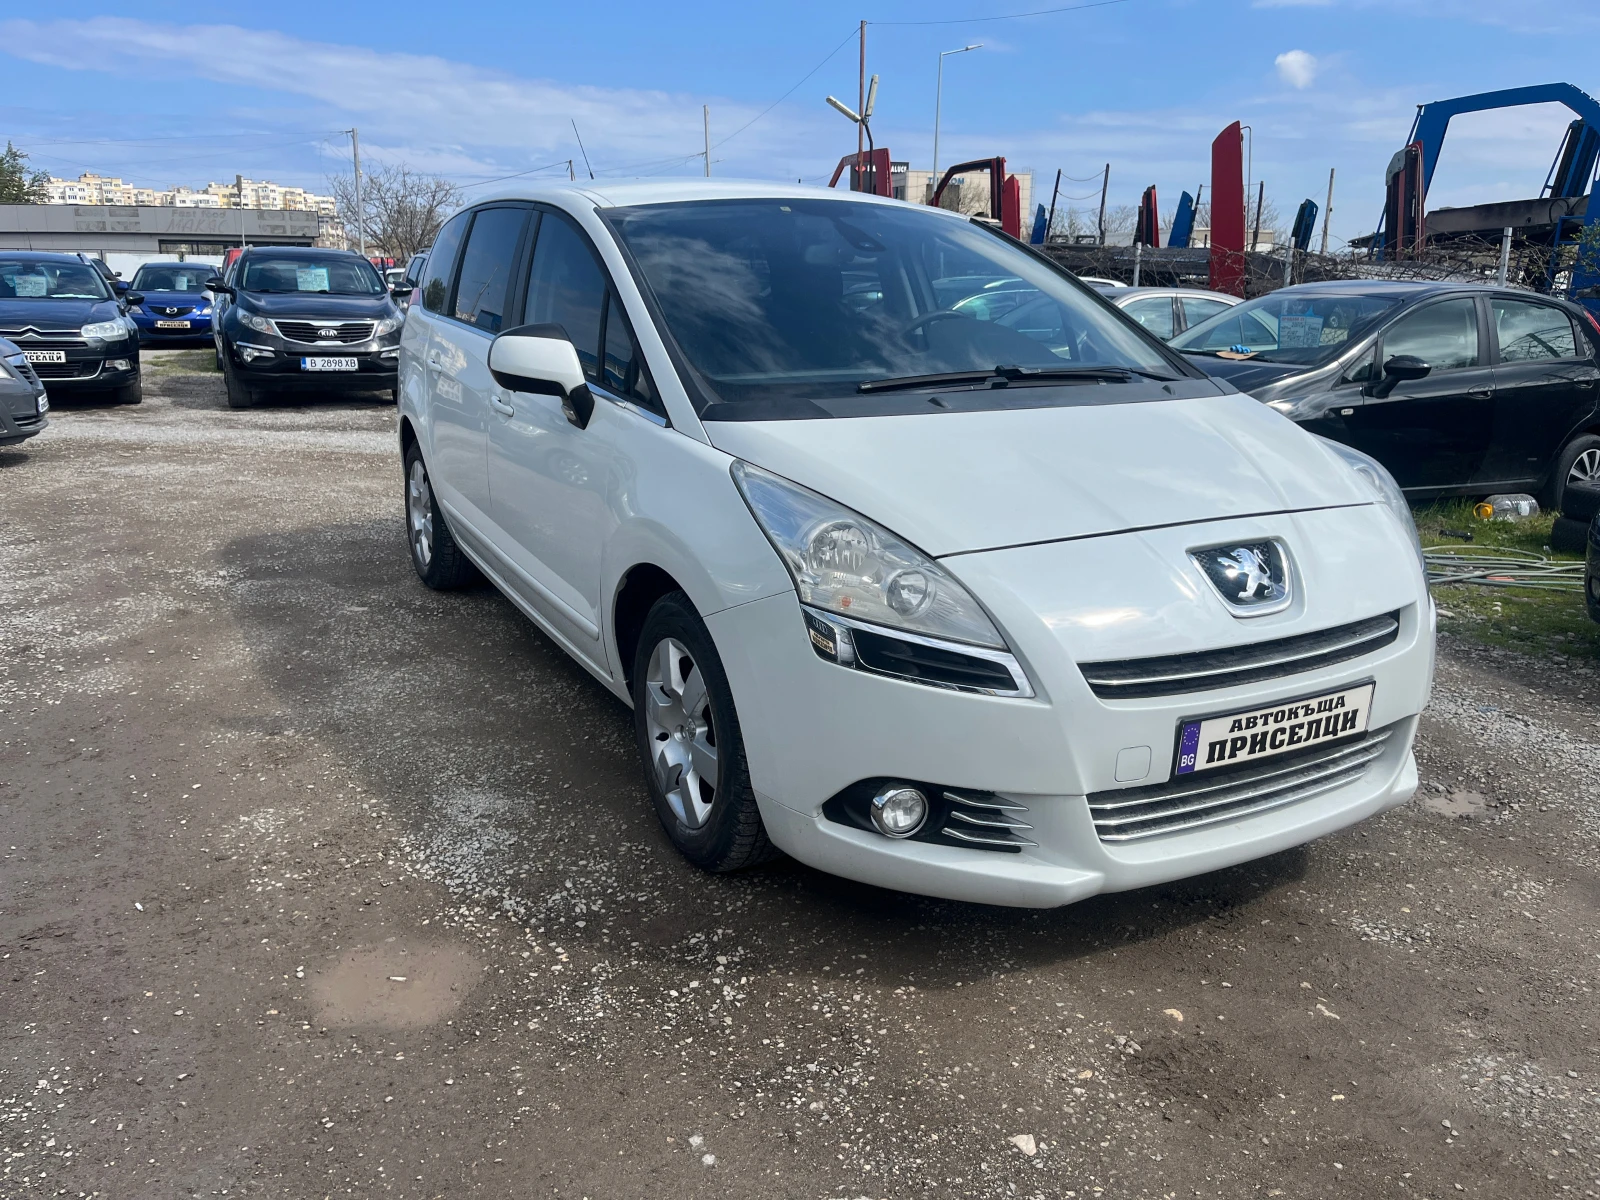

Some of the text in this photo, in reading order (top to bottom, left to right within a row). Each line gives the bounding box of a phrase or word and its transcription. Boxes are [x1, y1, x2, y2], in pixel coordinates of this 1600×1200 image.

[171, 209, 227, 219] Fast food
[320, 329, 335, 337] KIA
[310, 358, 317, 368] B
[320, 358, 343, 368] 2898
[1228, 695, 1346, 734] АВТОКЪЩА
[1205, 708, 1360, 764] ПРИСЕЛЦИ
[1181, 753, 1195, 767] BG
